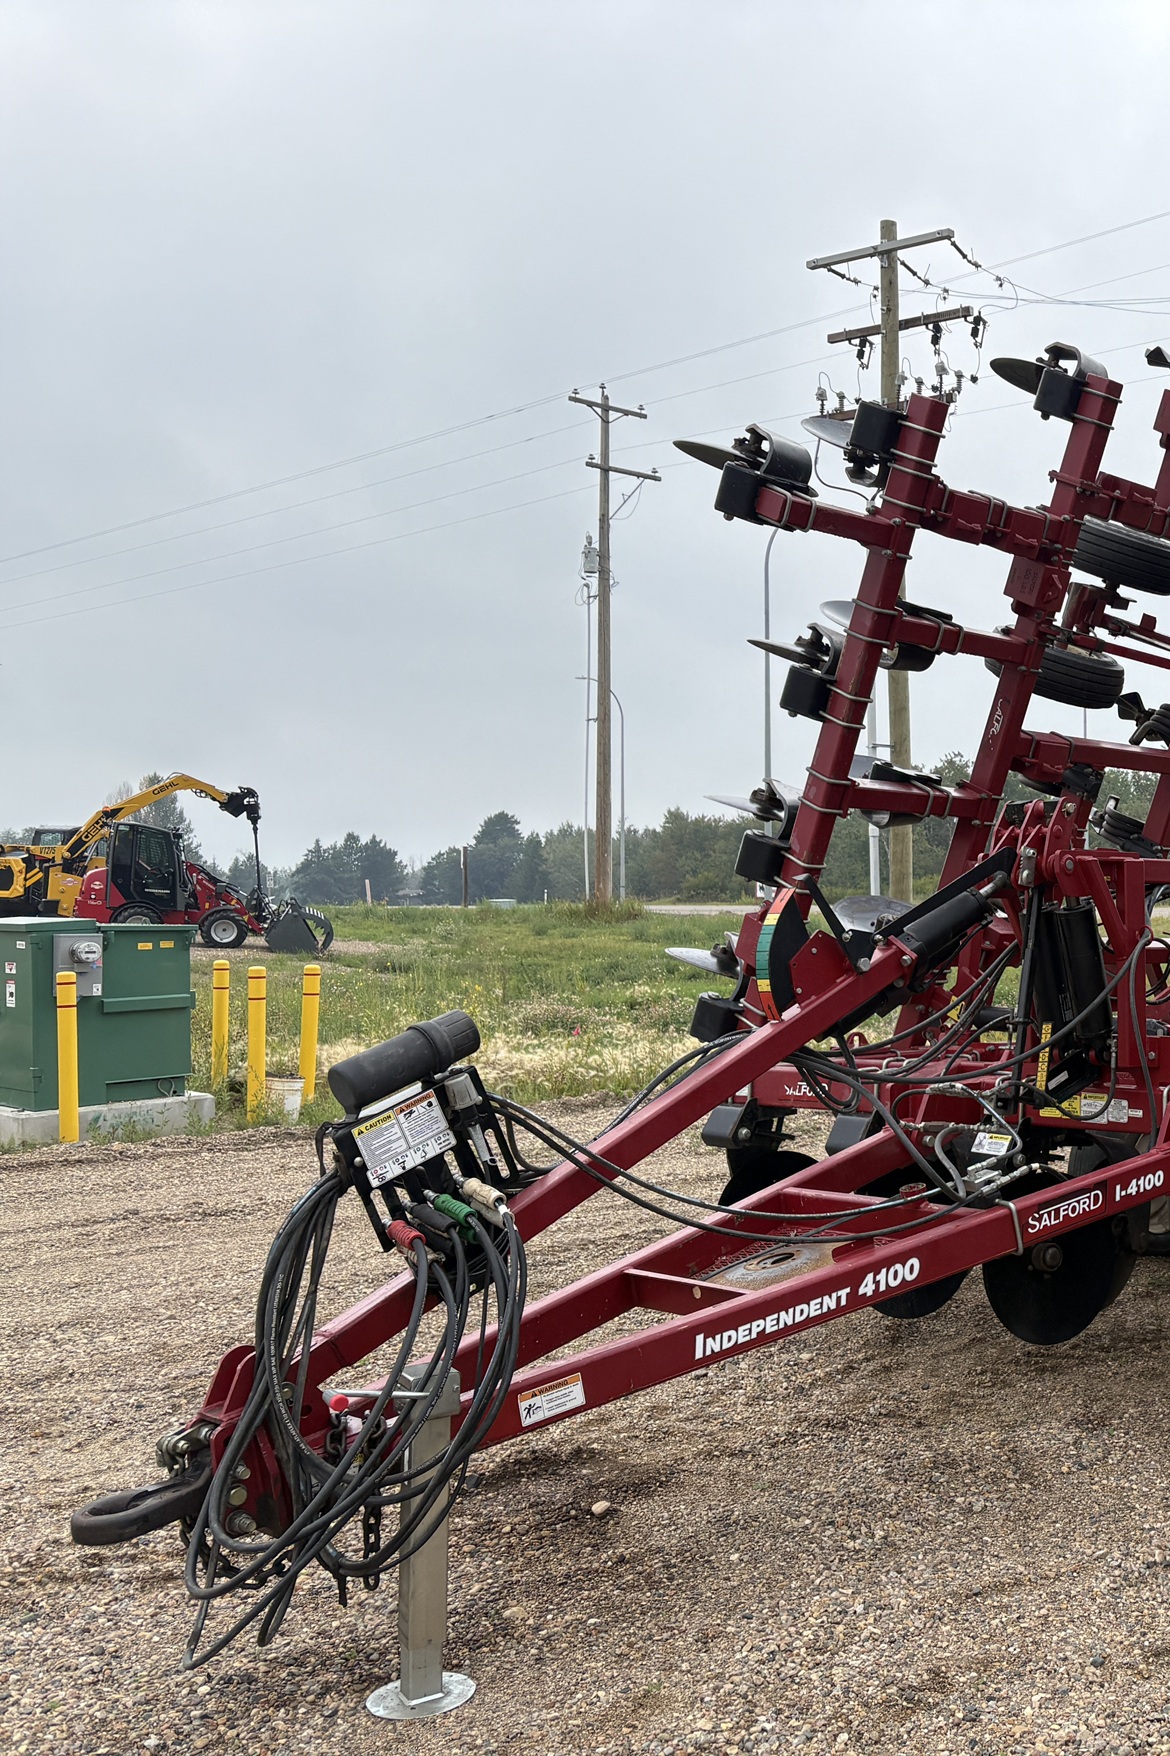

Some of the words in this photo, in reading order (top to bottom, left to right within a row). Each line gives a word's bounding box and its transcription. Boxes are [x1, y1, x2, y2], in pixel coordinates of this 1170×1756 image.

[152, 781, 180, 796] GEHL
[81, 816, 108, 842] GEH
[405, 1093, 431, 1111] WARNING
[364, 1114, 392, 1131] CAUTION
[1027, 1190, 1103, 1233] SALFORD
[1115, 1170, 1164, 1202] I-4100
[694, 1287, 851, 1360] INDEPENDENT
[858, 1257, 921, 1297] 4100
[538, 1380, 569, 1395] WARNING
